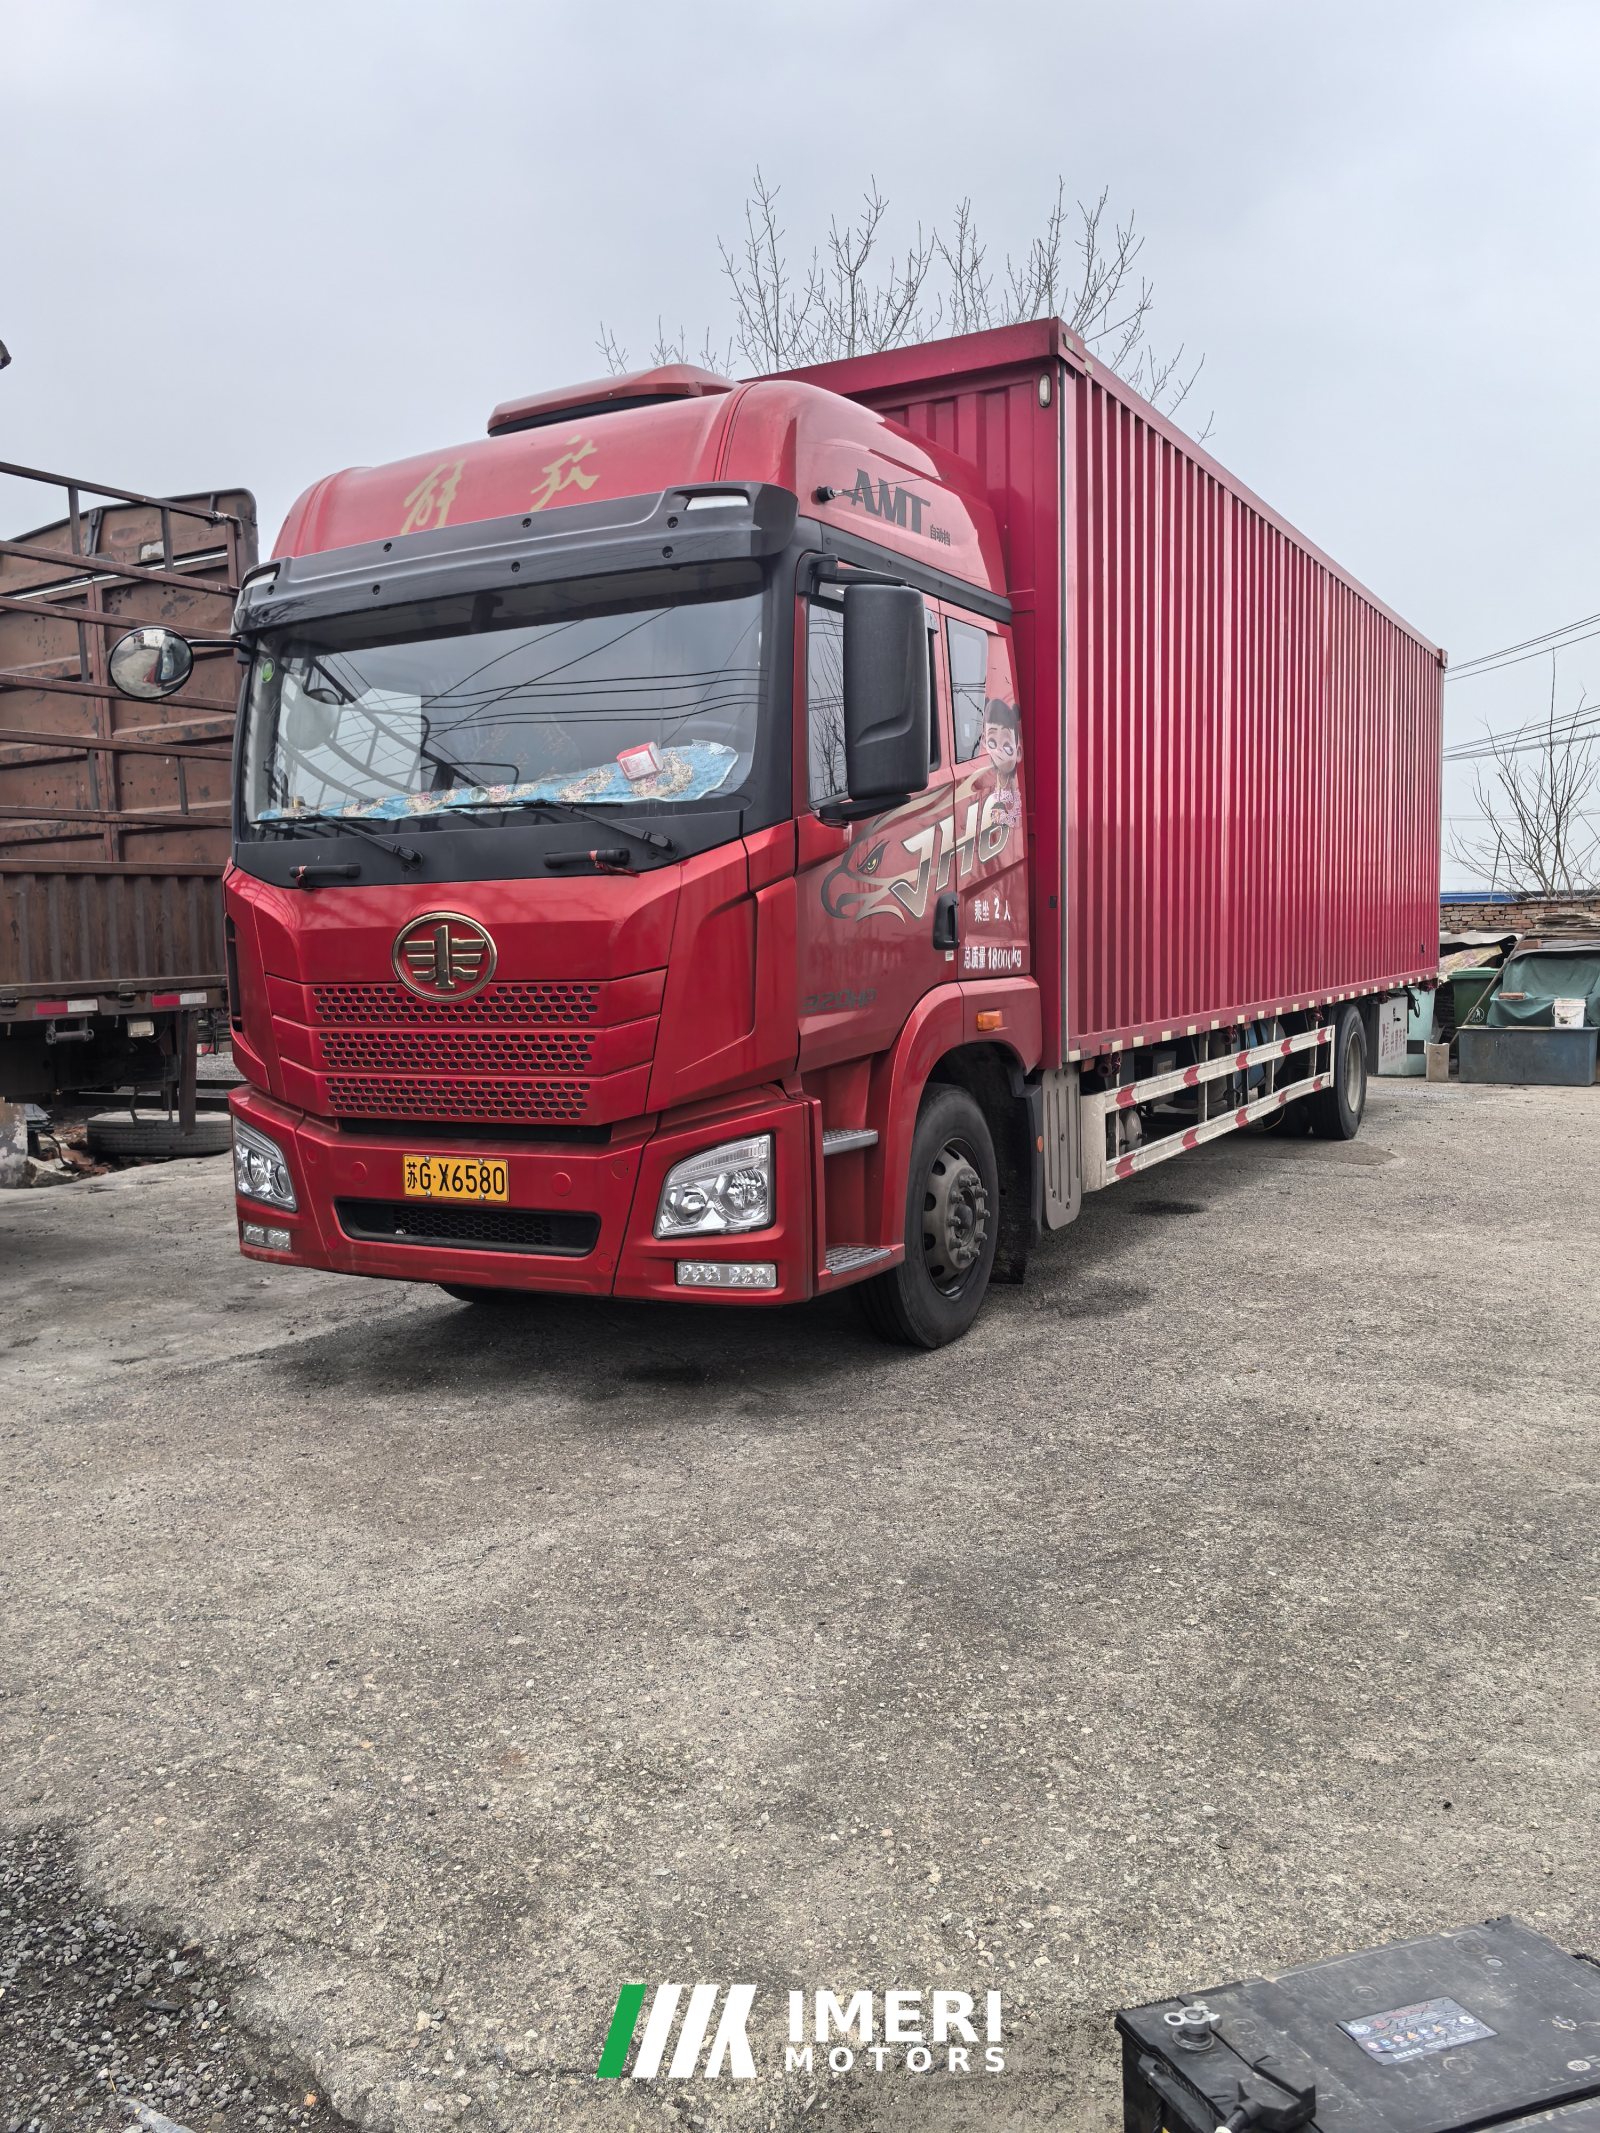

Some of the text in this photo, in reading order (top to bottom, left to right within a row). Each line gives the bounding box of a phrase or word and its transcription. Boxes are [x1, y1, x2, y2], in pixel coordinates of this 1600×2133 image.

[843, 468, 931, 535] AMT
[887, 795, 1011, 919] JH6
[993, 896, 1000, 919] 2
[1003, 899, 1011, 922] 人
